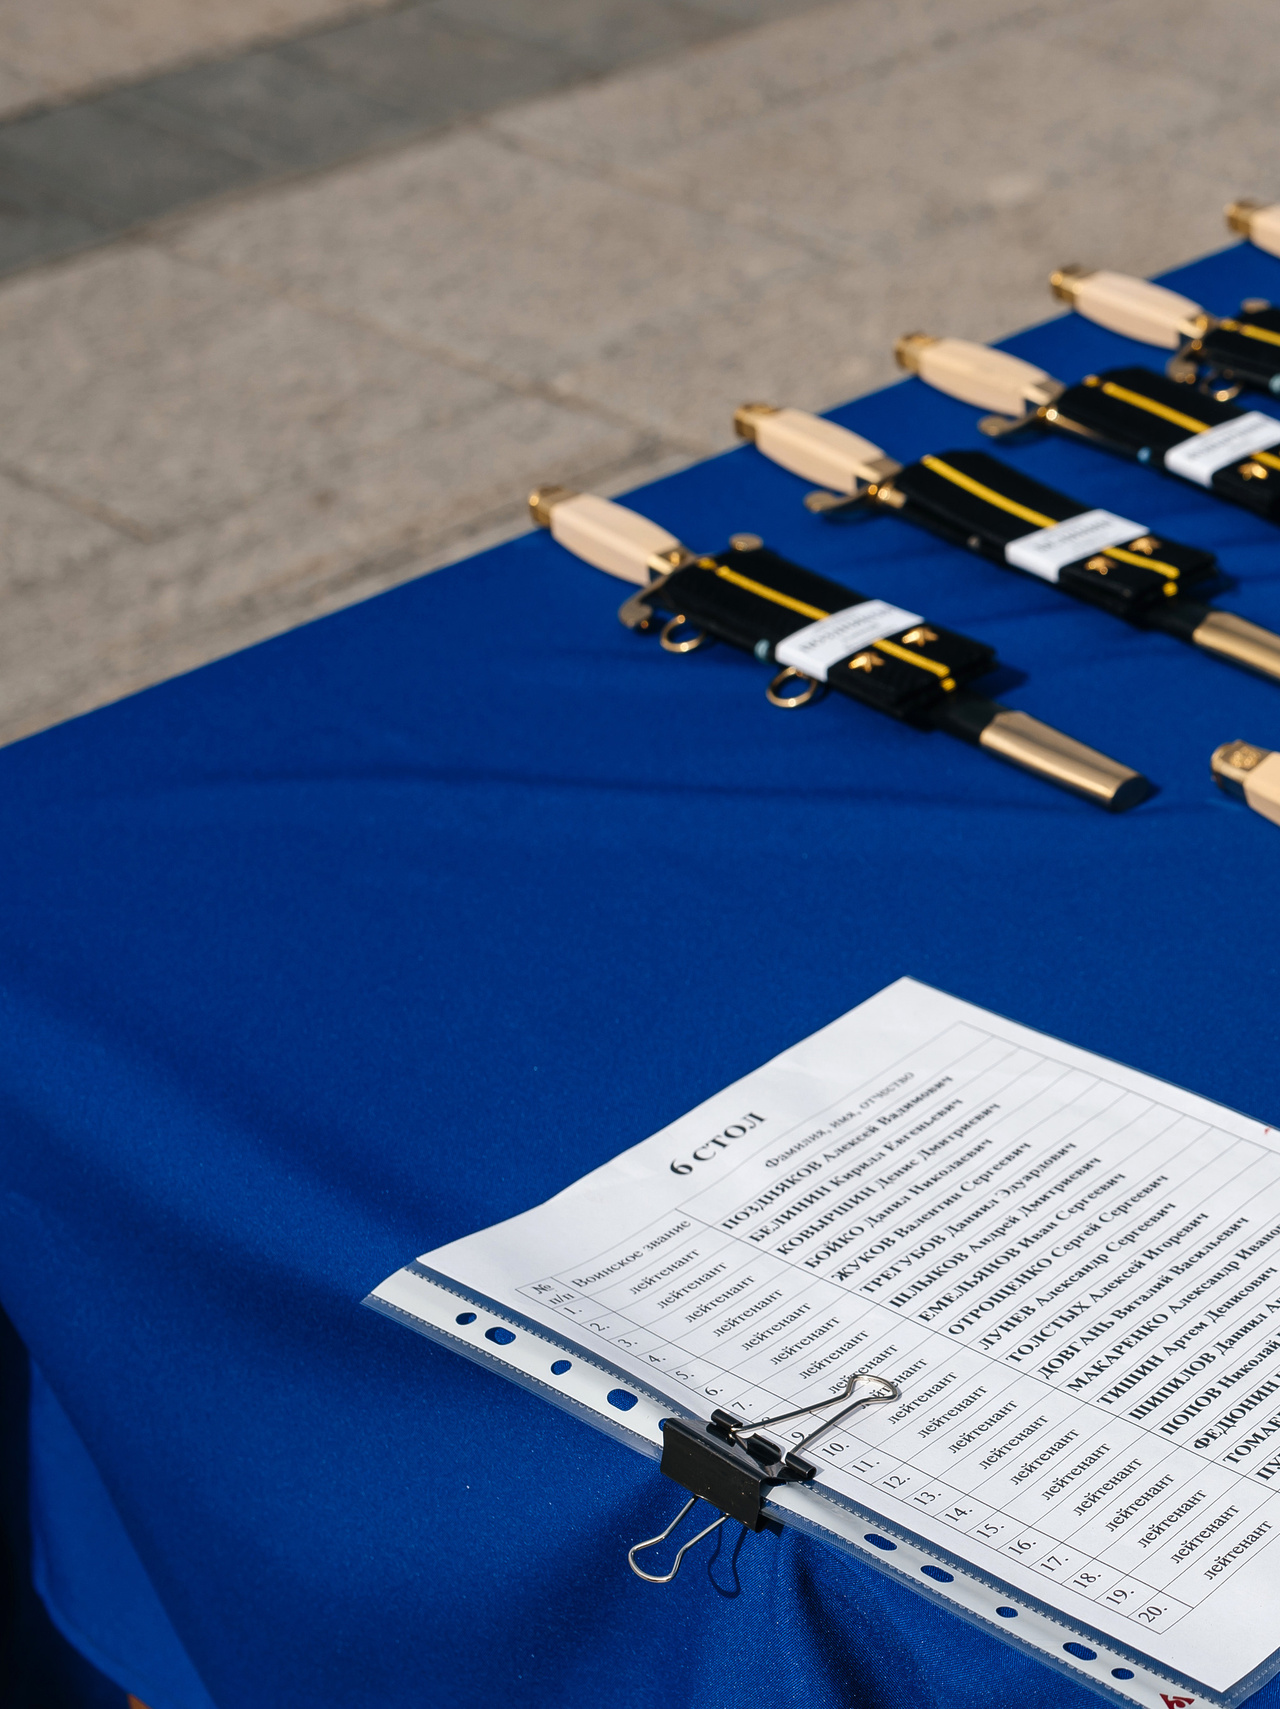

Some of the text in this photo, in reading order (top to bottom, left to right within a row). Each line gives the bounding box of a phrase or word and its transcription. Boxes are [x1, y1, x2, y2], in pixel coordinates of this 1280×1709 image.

[562, 1075, 954, 1316] 1. лейтенант ПОЗДНЯКОВ Алексей Вадимович
[588, 1097, 964, 1332] 2. лейтенант БЕЛИНИН Кирилл Евгеньевич
[616, 1102, 1001, 1348] 3. лейтенант КОВЫРШИН Денис Дмитриевич
[668, 1111, 767, 1177] 6 СТОЛ
[764, 1128, 832, 1169] Фамилия,
[858, 1071, 915, 1110] отчество
[530, 1282, 555, 1296] №
[547, 1292, 576, 1306] п/п
[570, 1219, 692, 1289] Воинское звание
[647, 1137, 994, 1364] 4. лейтенант БОЙКО Данил Николаевич
[674, 1141, 1032, 1381] 5. лейтенант ЖУКОВ Валентин Сергеевич
[703, 1141, 1078, 1397] 6. лейтенант ТРЕГУБОВ Даниил Эдуардович
[730, 1156, 1102, 1412] 7. лейтенант ШЛЫКОВ Андрей Дмитриевич
[820, 1201, 1177, 1457] 10. лейтенант ЛУНЕВ Александр Сергеевич
[850, 1211, 1210, 1474] 11. лейтенант ТОЛСТЫХ Алексей Игоревич
[852, 1356, 932, 1410] йтенант
[947, 1256, 1054, 1336] ОТРОЩЕНКО
[1049, 1222, 1103, 1259] Сергей
[1097, 1174, 1169, 1224] Сергеевич
[881, 1215, 1250, 1490] 12. лейтенант ДОВГАНЬ Виталий Васильевич
[916, 1246, 1022, 1323] ЕМЕЛЬЯНОВ
[1015, 1220, 1059, 1249] Иван
[1054, 1172, 1127, 1222] Сергеевич
[912, 1490, 943, 1506] 13.
[977, 1413, 1049, 1471] лейтенант
[1064, 1312, 1170, 1394] МАКАРЕНКО
[1166, 1259, 1241, 1315] Александр
[943, 1265, 1279, 1523] 14. лейтенант ТИШИН Артем Денисович
[975, 1522, 1005, 1539] 15.
[1040, 1442, 1112, 1502] лейтенант
[1126, 1351, 1217, 1421] ШИПИЛОВ
[1210, 1311, 1269, 1357] Даниил
[1006, 1538, 1037, 1556] 16.
[1071, 1457, 1143, 1517] лейтенант
[1157, 1386, 1223, 1437] ПОПОВ
[1038, 1554, 1070, 1573] 17.
[1104, 1472, 1175, 1533] лейтенант
[1071, 1571, 1103, 1589] 18.
[1136, 1488, 1208, 1549] лейтенант
[1104, 1588, 1136, 1606] 19.
[1169, 1503, 1240, 1565] лейтенант
[1136, 1604, 1169, 1624] 20.
[1202, 1519, 1274, 1582] лейтенант
